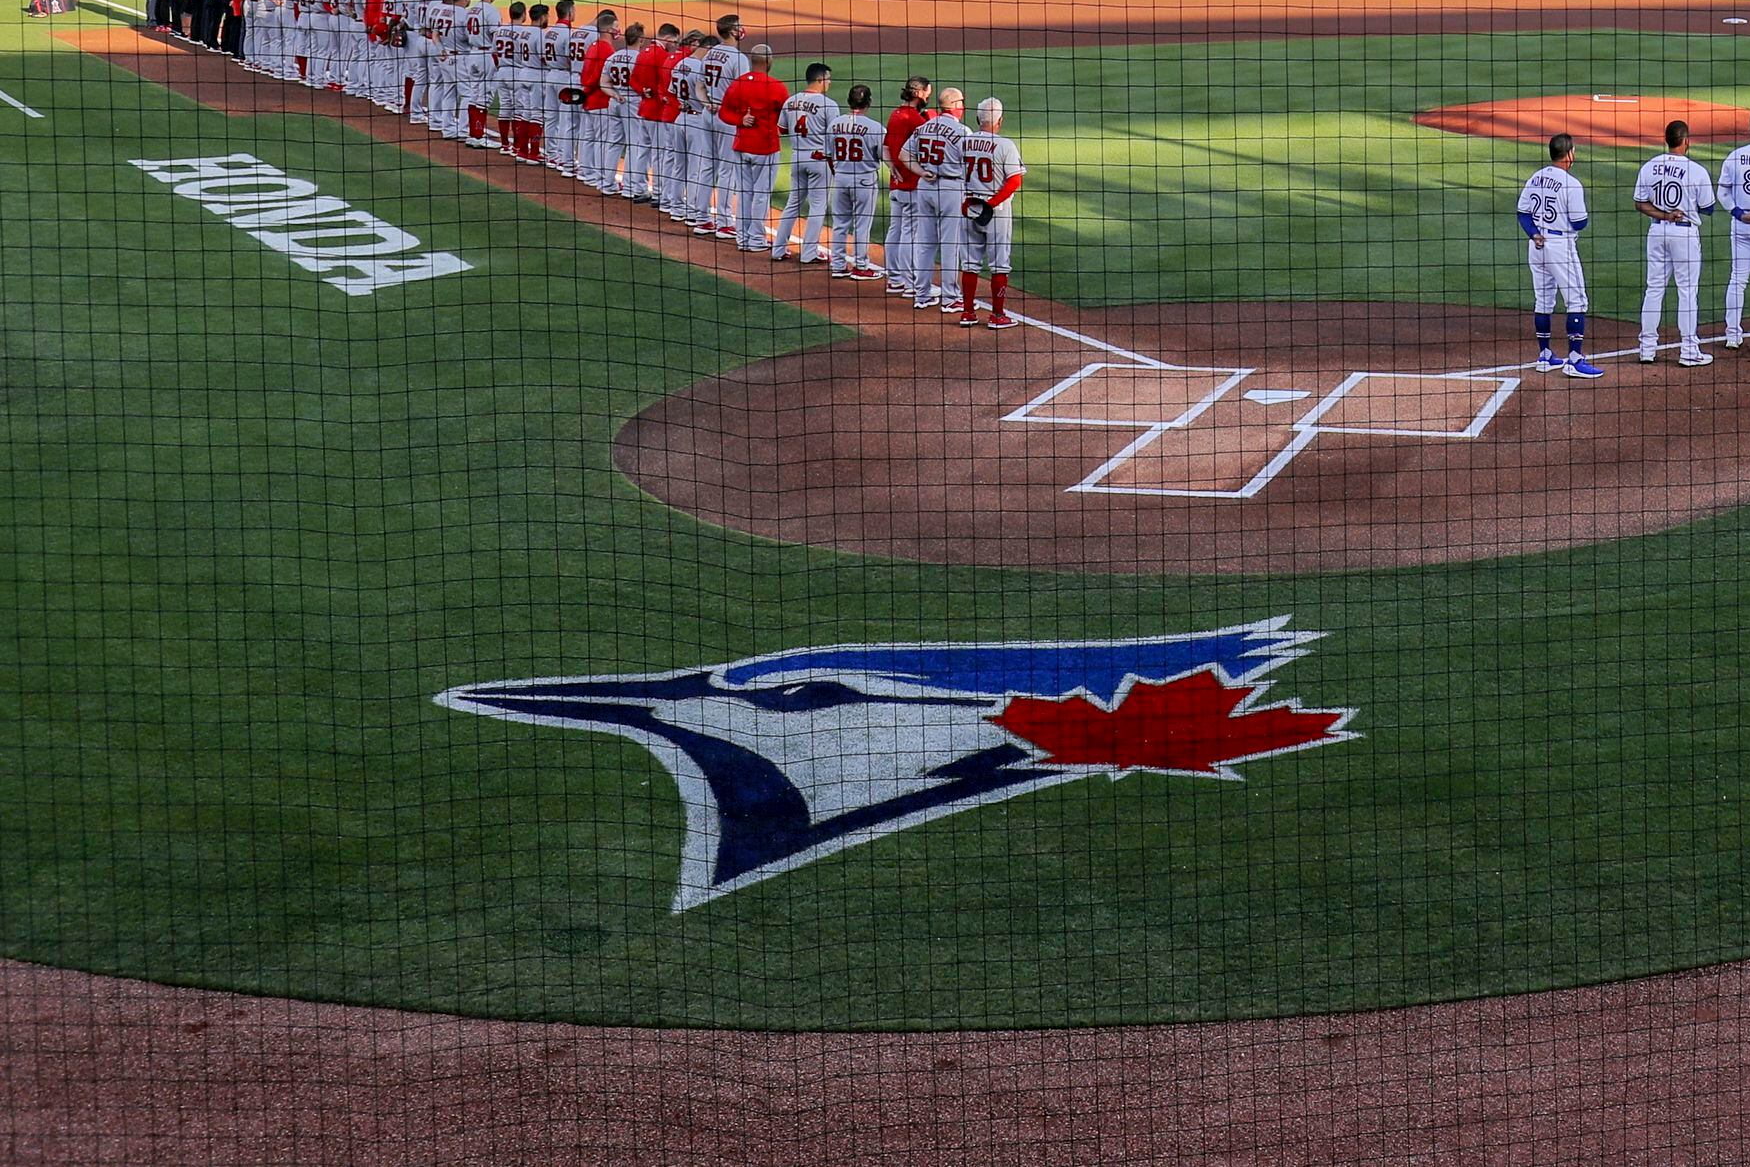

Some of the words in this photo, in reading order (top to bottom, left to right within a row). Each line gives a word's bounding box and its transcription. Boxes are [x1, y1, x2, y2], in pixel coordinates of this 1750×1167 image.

[437, 18, 452, 37] 27
[496, 40, 515, 60] 22
[610, 66, 630, 87] 33
[704, 64, 722, 88] 57
[787, 100, 820, 115] IGLESIAS
[794, 114, 808, 138] 4
[832, 122, 868, 137] GALLEGO
[835, 137, 863, 162] 86
[917, 138, 946, 166] 55
[963, 155, 993, 183] 70
[1652, 165, 1686, 180] SEMIEN
[1531, 176, 1563, 193] MONTOYO
[1650, 179, 1683, 209] 10
[1530, 193, 1557, 224] 25
[127, 152, 475, 297] HONDA
